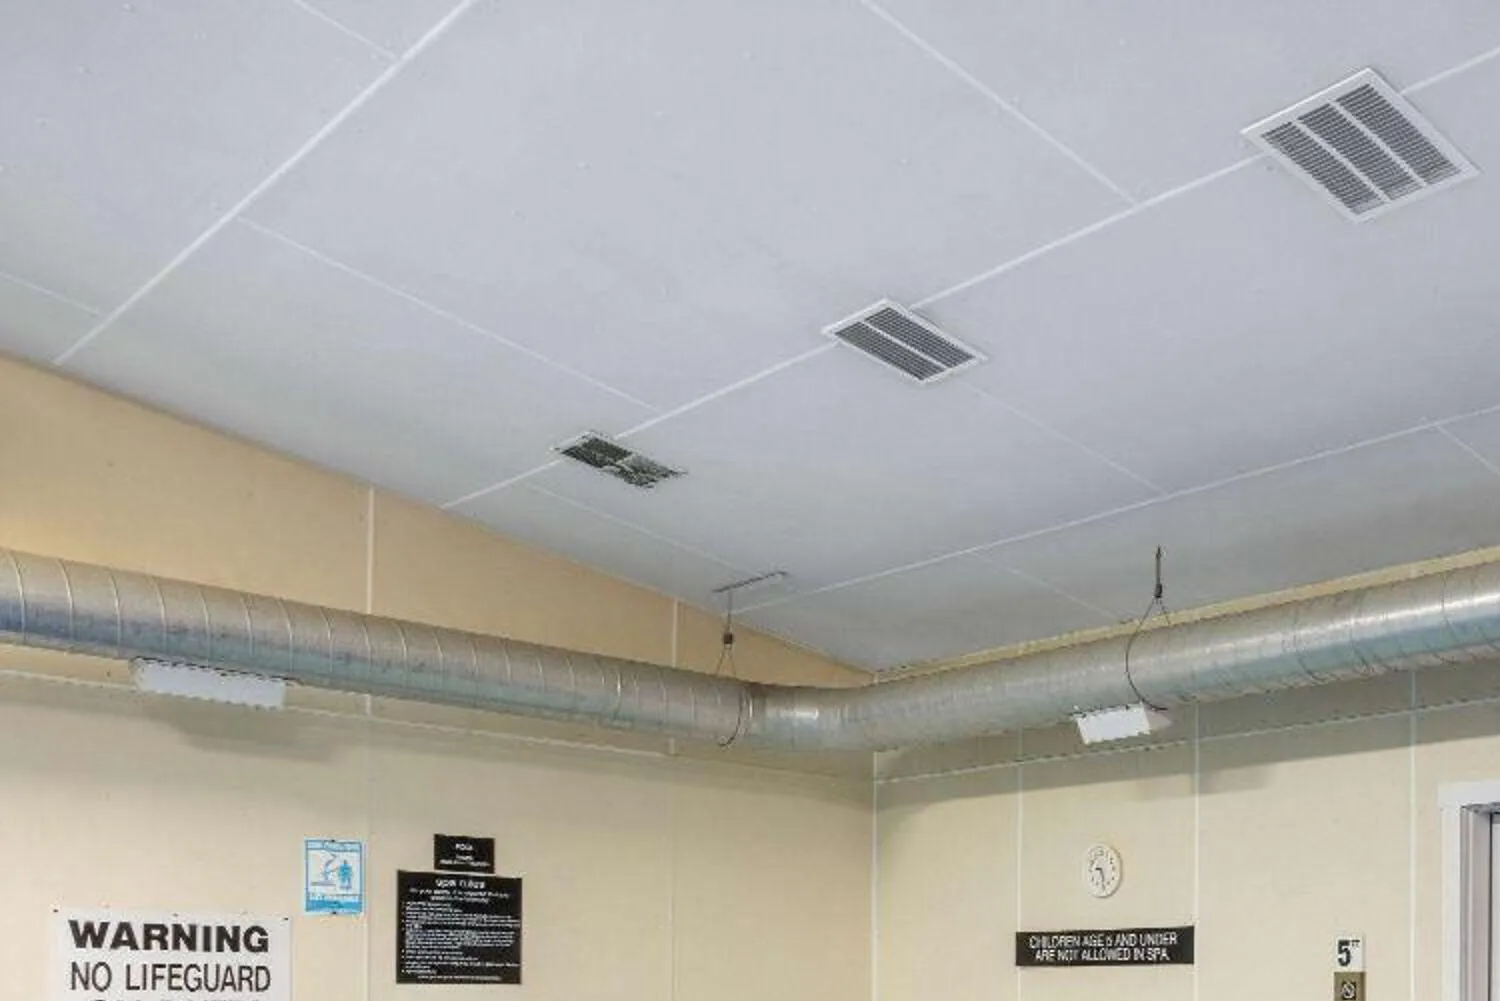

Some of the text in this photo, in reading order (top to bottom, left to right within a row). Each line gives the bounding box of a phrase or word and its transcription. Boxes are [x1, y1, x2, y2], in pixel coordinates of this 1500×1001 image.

[68, 919, 269, 953] WARNING
[1029, 935, 1080, 949] CHILDREN
[1083, 934, 1104, 947] AGE
[1114, 933, 1137, 947] AND
[1139, 931, 1178, 946] UNDER
[1035, 949, 1055, 962] ARE
[1057, 949, 1079, 962] NOT
[1081, 948, 1130, 961] ALLOWED
[1133, 948, 1145, 961] IN
[1337, 939, 1351, 967] 5
[70, 961, 272, 992] NO LIFEGUARD
